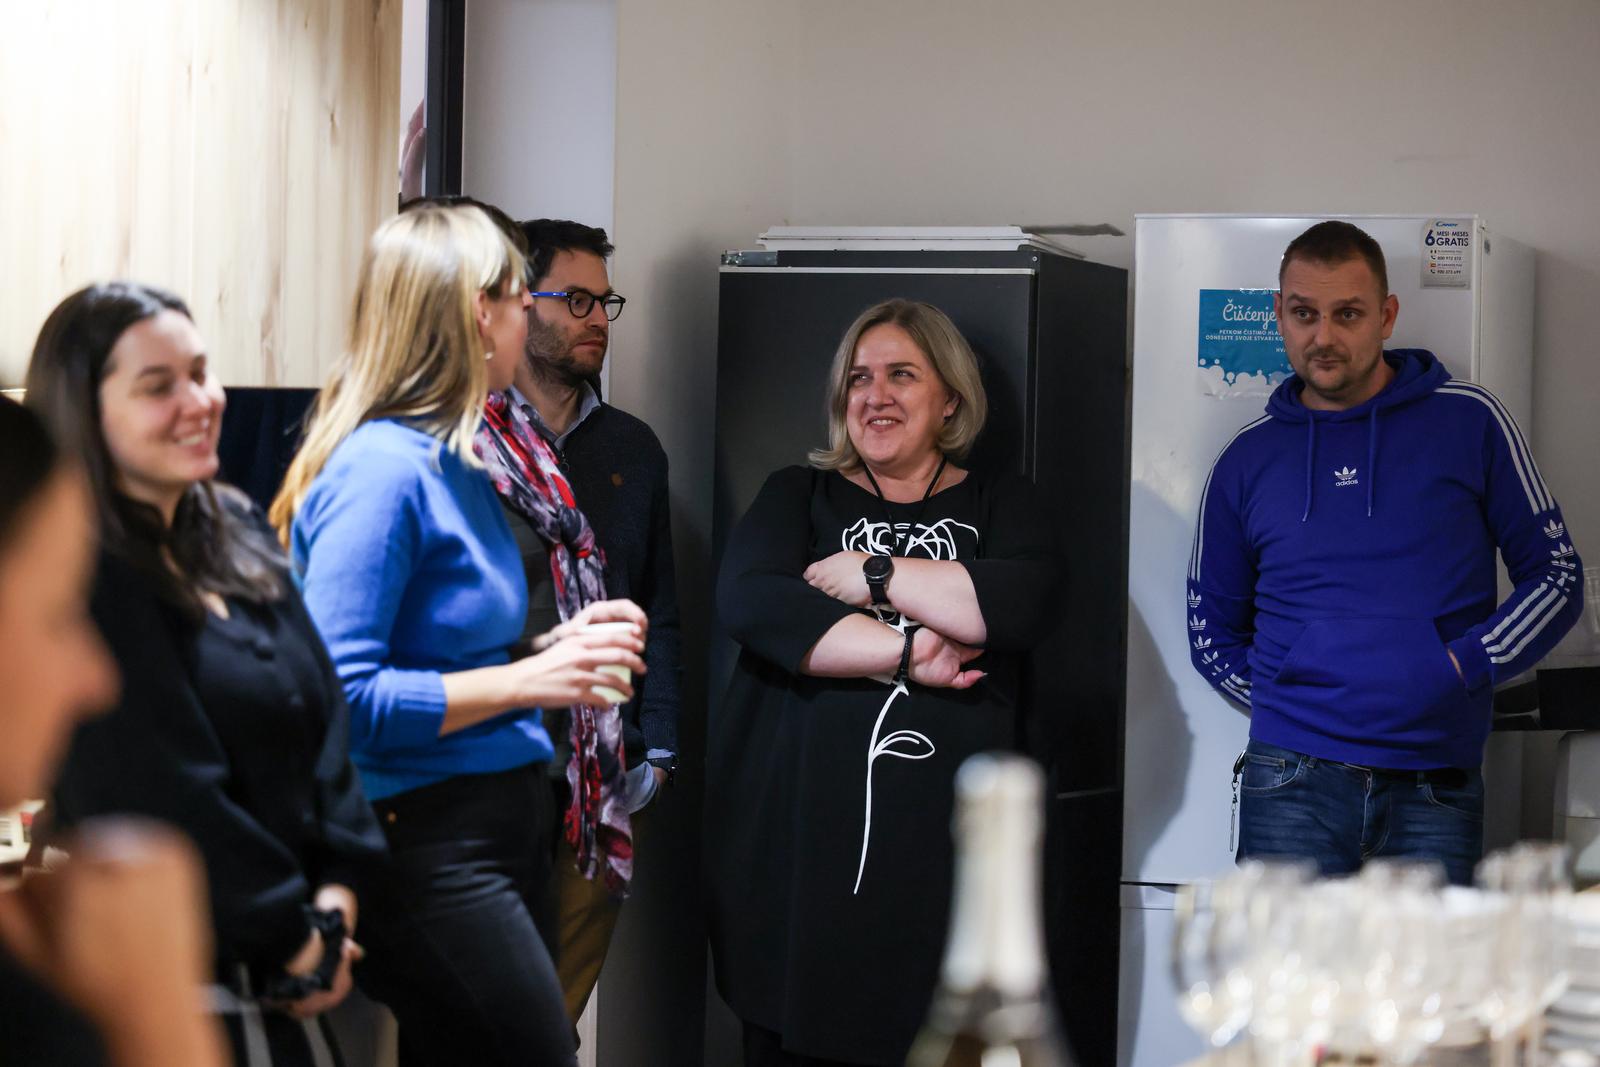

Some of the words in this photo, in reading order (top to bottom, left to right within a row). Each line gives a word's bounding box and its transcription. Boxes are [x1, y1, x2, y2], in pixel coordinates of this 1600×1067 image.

[1425, 229, 1435, 246] 6
[1436, 237, 1469, 247] GRATIS
[1223, 299, 1277, 330] Čišćenje
